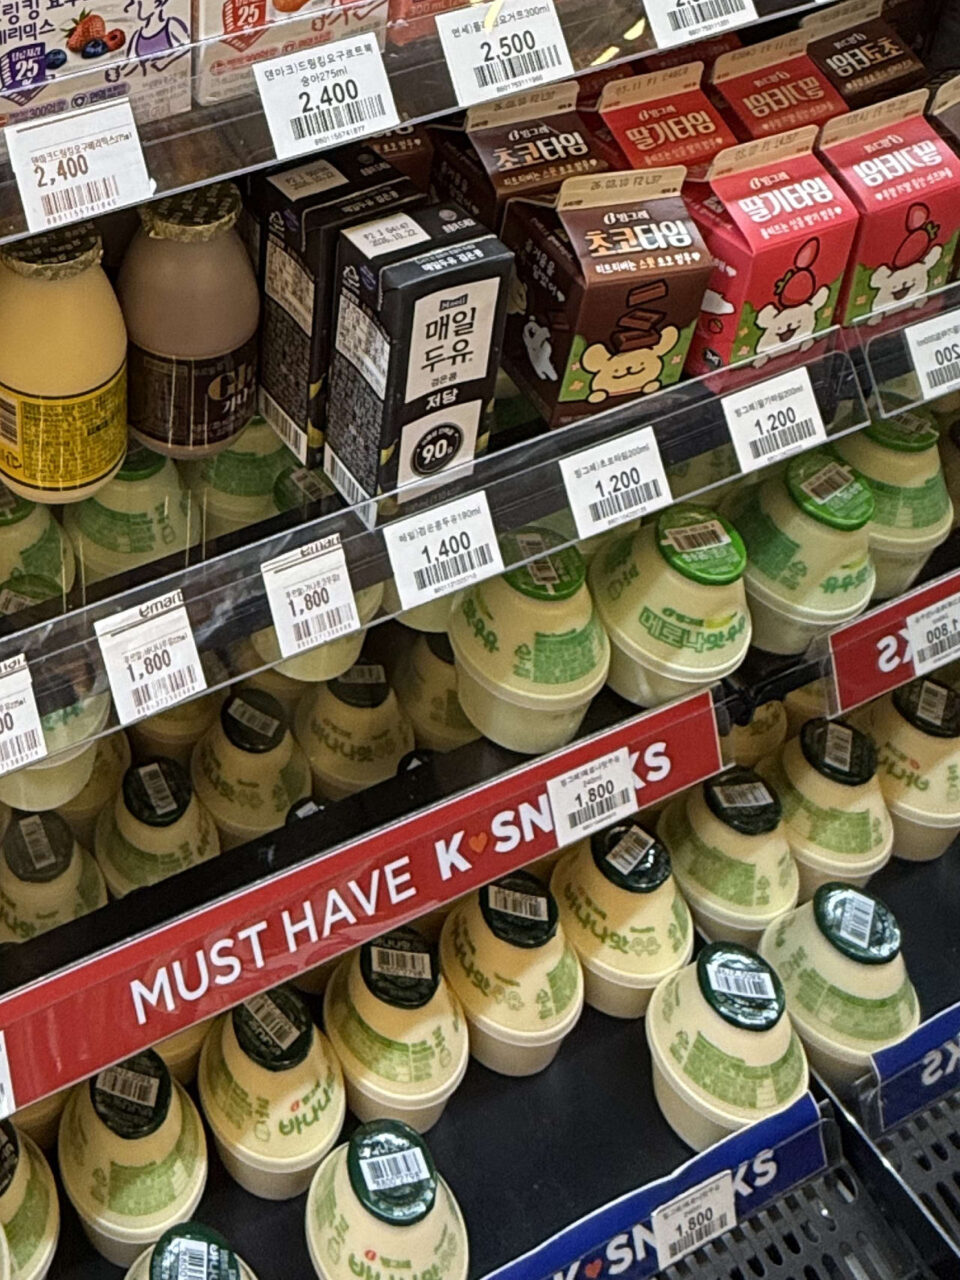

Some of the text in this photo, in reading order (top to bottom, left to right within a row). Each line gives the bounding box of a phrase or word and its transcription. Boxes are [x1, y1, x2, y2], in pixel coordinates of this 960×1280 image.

[480, 30, 536, 62] 2,500
[298, 79, 358, 113] 2,400
[625, 111, 717, 151] 딸기타임
[492, 131, 589, 171] 초코타임
[34, 154, 88, 188] 2,400
[737, 177, 834, 223] 딸기타임
[585, 220, 693, 257] 초코타임
[425, 307, 476, 340] 매일
[421, 339, 474, 373] 두유
[426, 388, 458, 410] 저당
[754, 407, 797, 436] 1,200
[595, 466, 641, 500] 1,200
[421, 531, 471, 568] 1,400
[288, 587, 329, 617] 1,800
[126, 649, 171, 682] 1,800
[575, 780, 614, 808] 1,800
[129, 919, 269, 1026] MUST
[280, 854, 417, 955] HAVE
[490, 741, 672, 854] SNKS
[675, 1207, 713, 1237] 1,800
